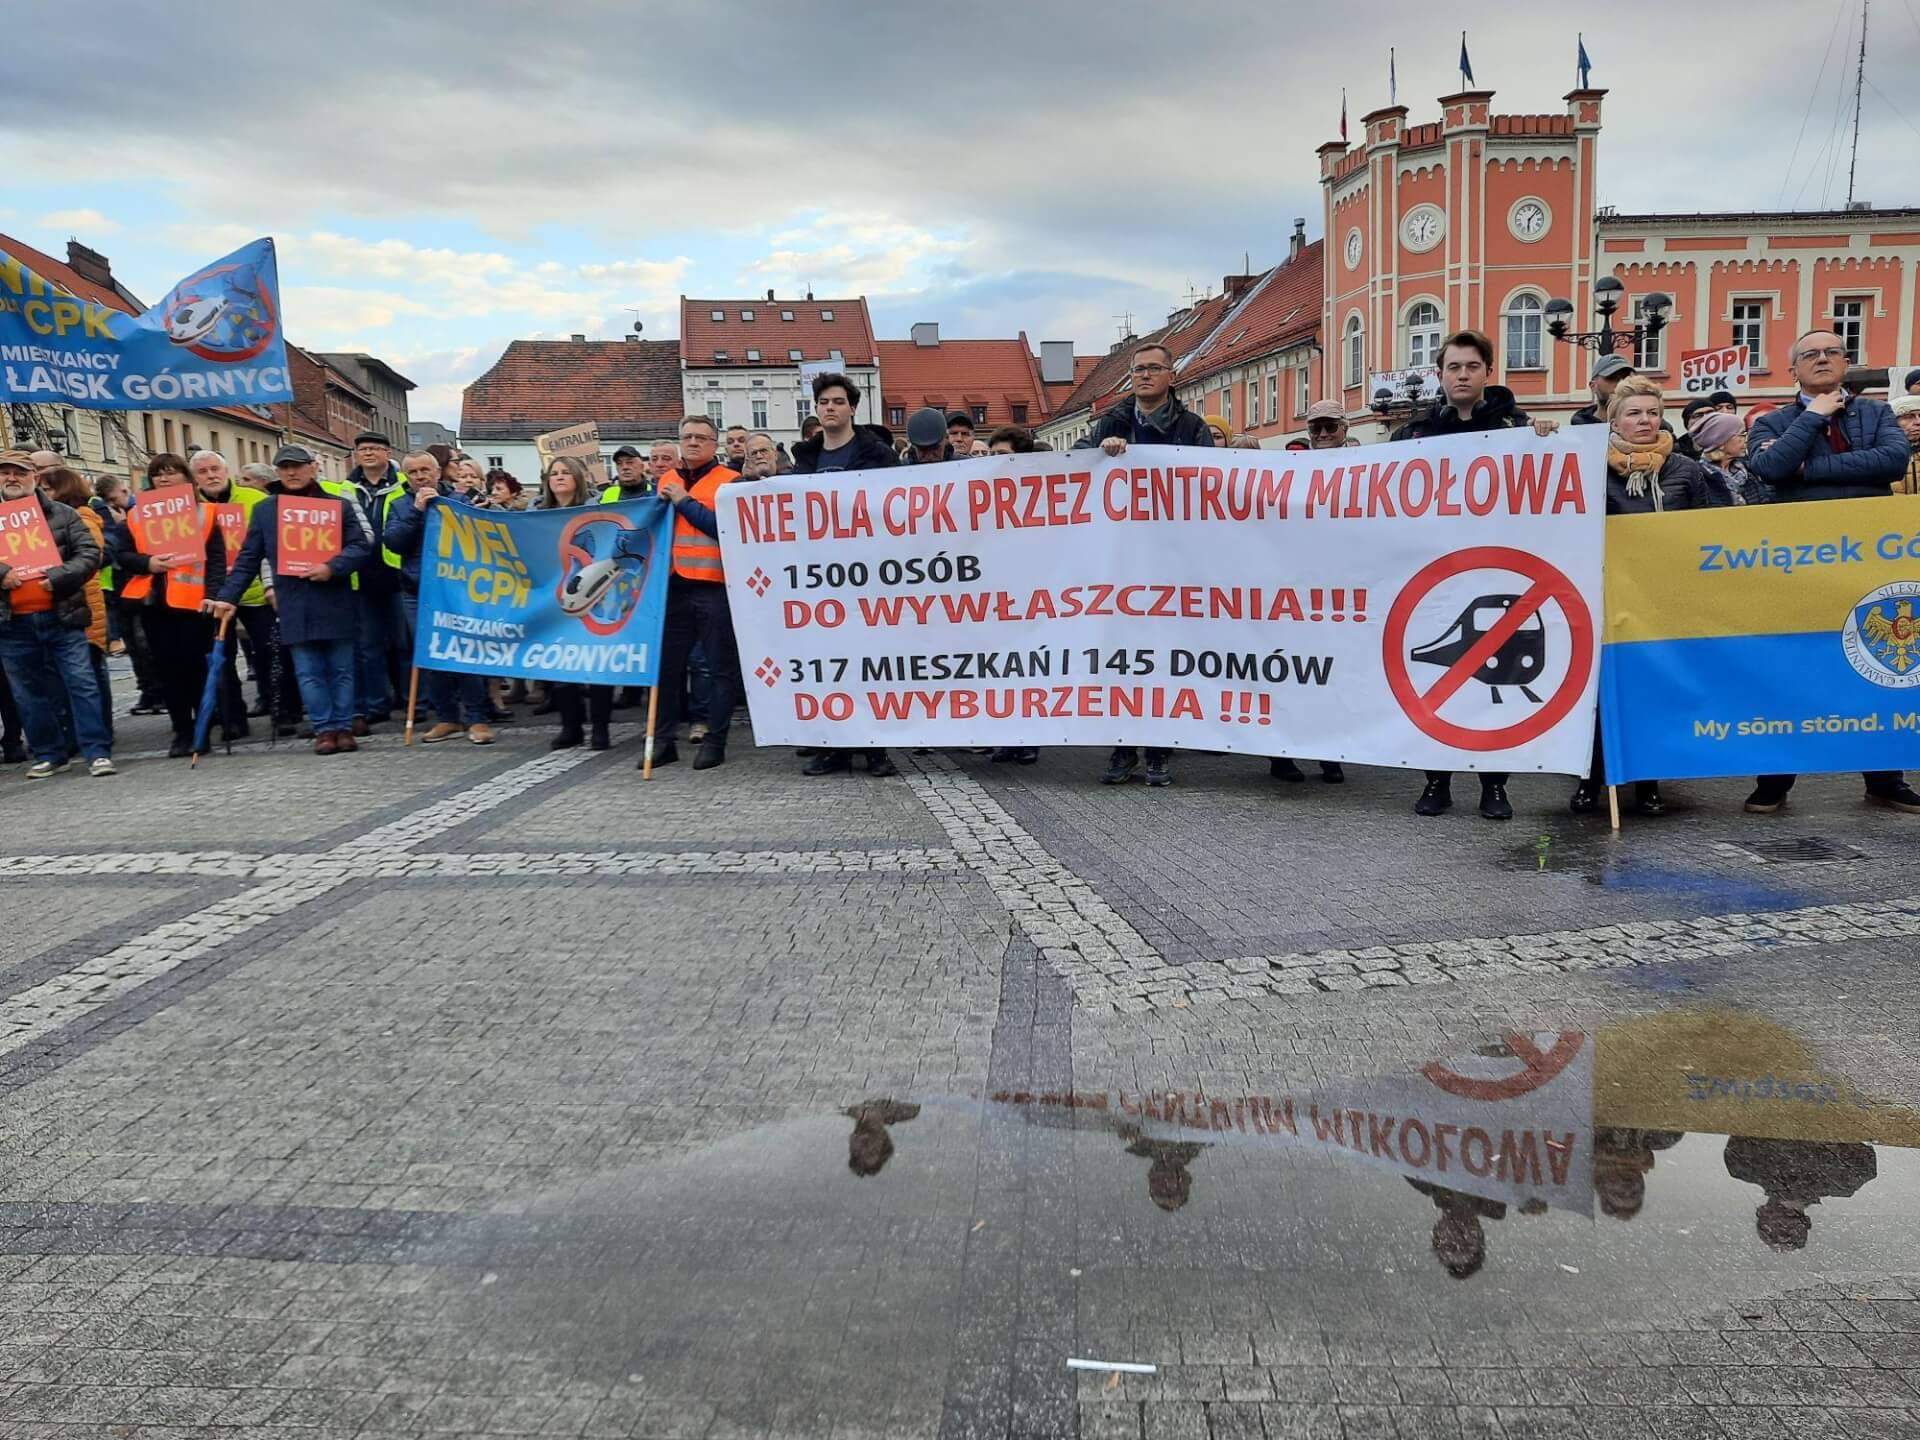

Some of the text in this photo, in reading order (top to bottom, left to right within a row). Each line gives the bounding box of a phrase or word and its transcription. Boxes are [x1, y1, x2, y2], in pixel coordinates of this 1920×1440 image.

[24, 300, 115, 340] CPK
[1382, 372, 1397, 382] NIE
[1683, 346, 1748, 384] STOP!
[1686, 376, 1728, 392] CPK
[143, 494, 192, 518] STOP!
[736, 452, 1586, 544] NIE DLA CPK PRZEZ CENTRUM MIKOŁOWA
[0, 507, 40, 532] TOP!
[145, 515, 196, 545] CPK
[282, 508, 337, 527] STOP!
[0, 525, 48, 561] PK
[282, 525, 336, 552] CPK
[1699, 530, 1920, 574] Związek Gó
[437, 562, 466, 581] DLA
[783, 551, 981, 589] 1500 OSÓB
[1877, 582, 1920, 599] SILESI
[783, 584, 1368, 629] DO WYWŁASZCZENIA!!!
[433, 610, 525, 638] MIESZKAŃCY
[522, 636, 648, 673] GÓRNYCH
[789, 658, 849, 683] 317
[862, 645, 1051, 682] MIESZKAŃ
[1083, 648, 1155, 676] 145
[1170, 648, 1334, 686] DOMÓW
[795, 686, 1272, 726] DO WYBURZENIA !!!
[1693, 719, 1730, 740] My
